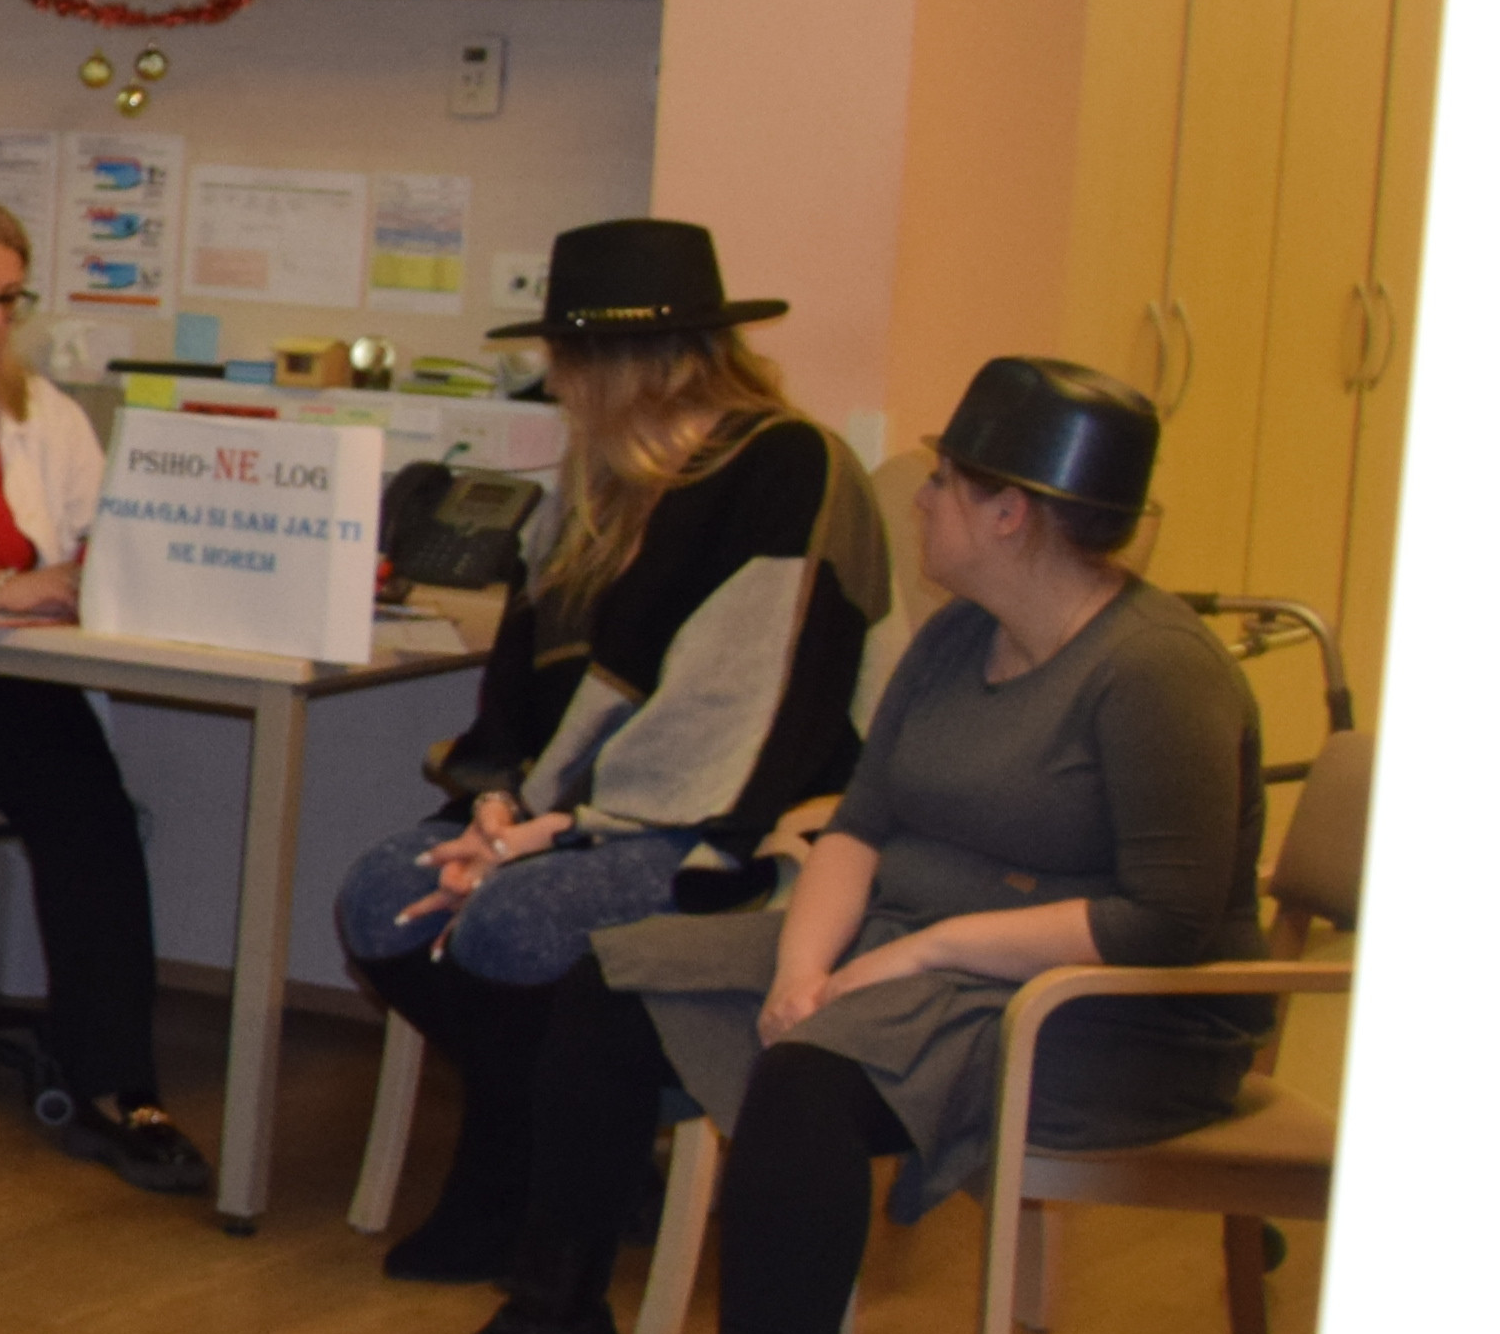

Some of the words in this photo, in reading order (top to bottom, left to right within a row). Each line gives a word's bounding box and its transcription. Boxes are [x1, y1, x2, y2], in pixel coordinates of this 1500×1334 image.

[233, 510, 279, 534] SAM
[283, 516, 329, 540] JAZ
[338, 519, 363, 542] TI
[168, 542, 195, 563] NE
